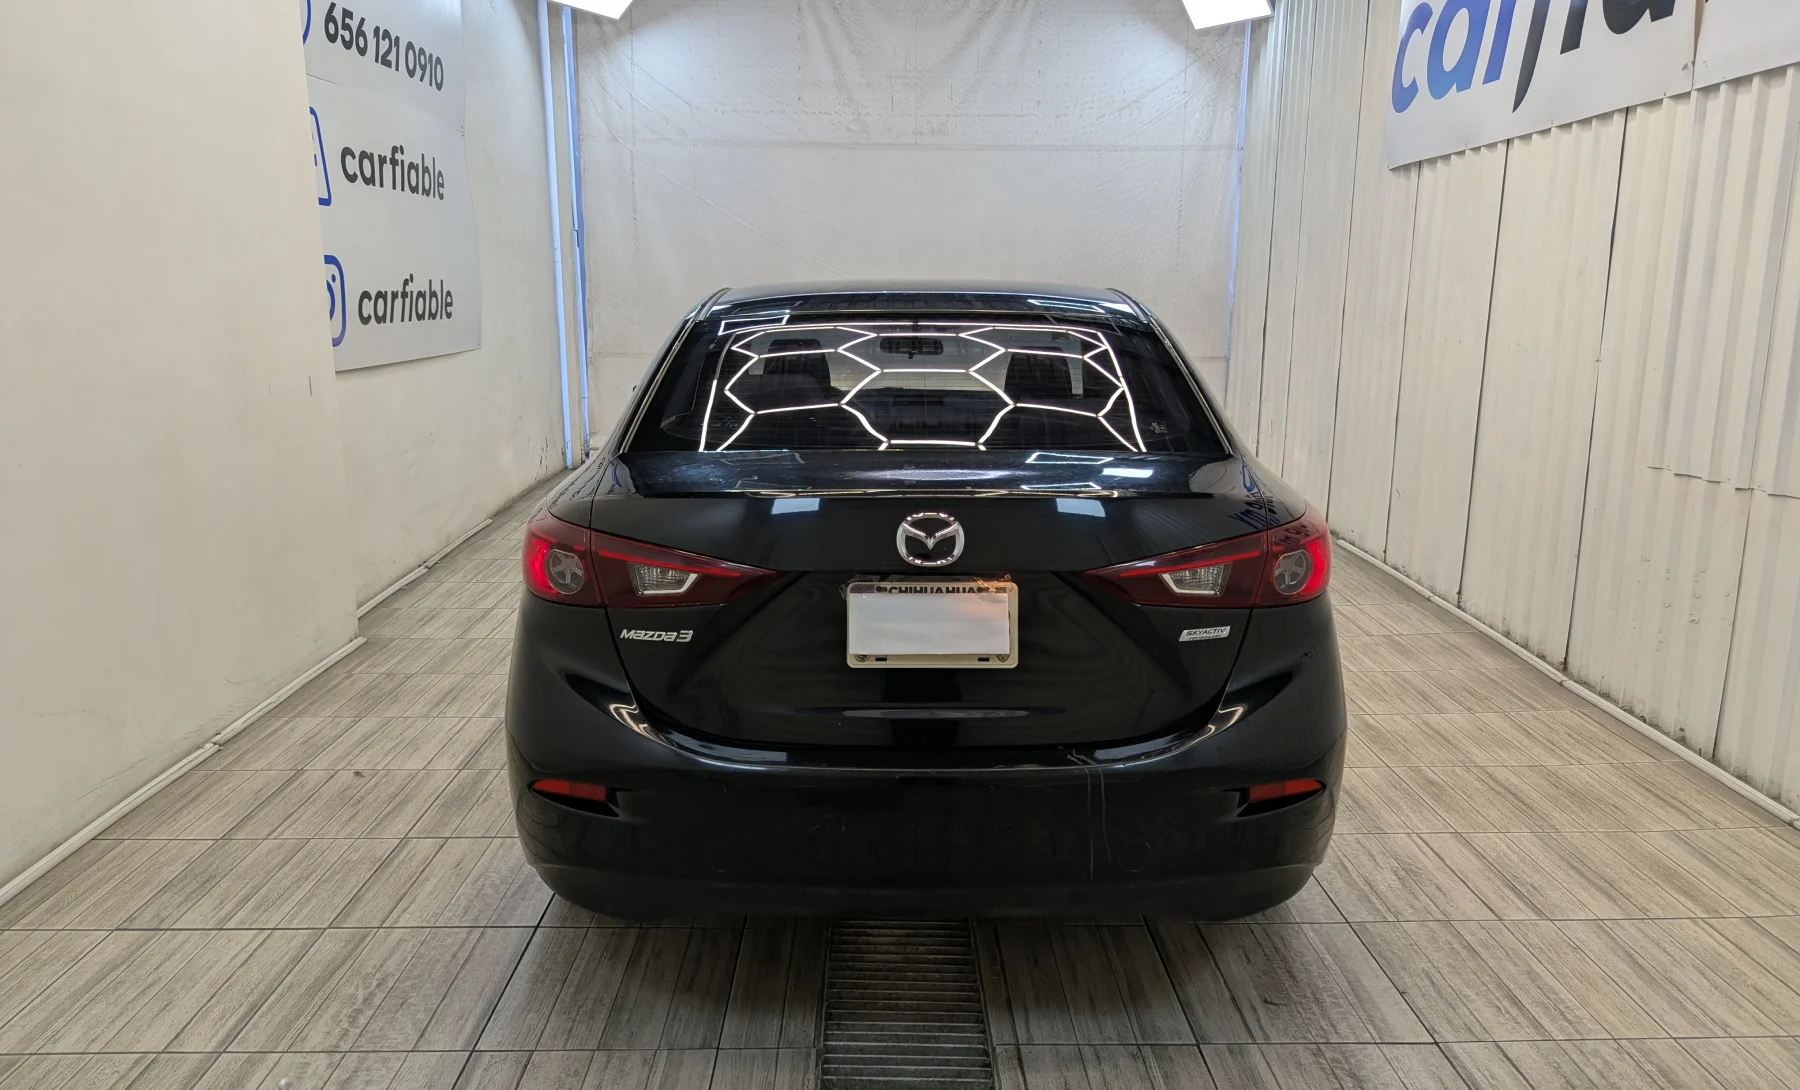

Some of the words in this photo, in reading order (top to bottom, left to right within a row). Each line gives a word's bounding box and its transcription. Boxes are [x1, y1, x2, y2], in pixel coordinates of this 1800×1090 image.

[324, 1, 368, 57] 656
[372, 25, 400, 72] 121
[404, 41, 444, 91] 0910
[340, 145, 445, 200] carfiable
[357, 273, 454, 326] carfiable
[1186, 627, 1227, 636] SKYACTIV
